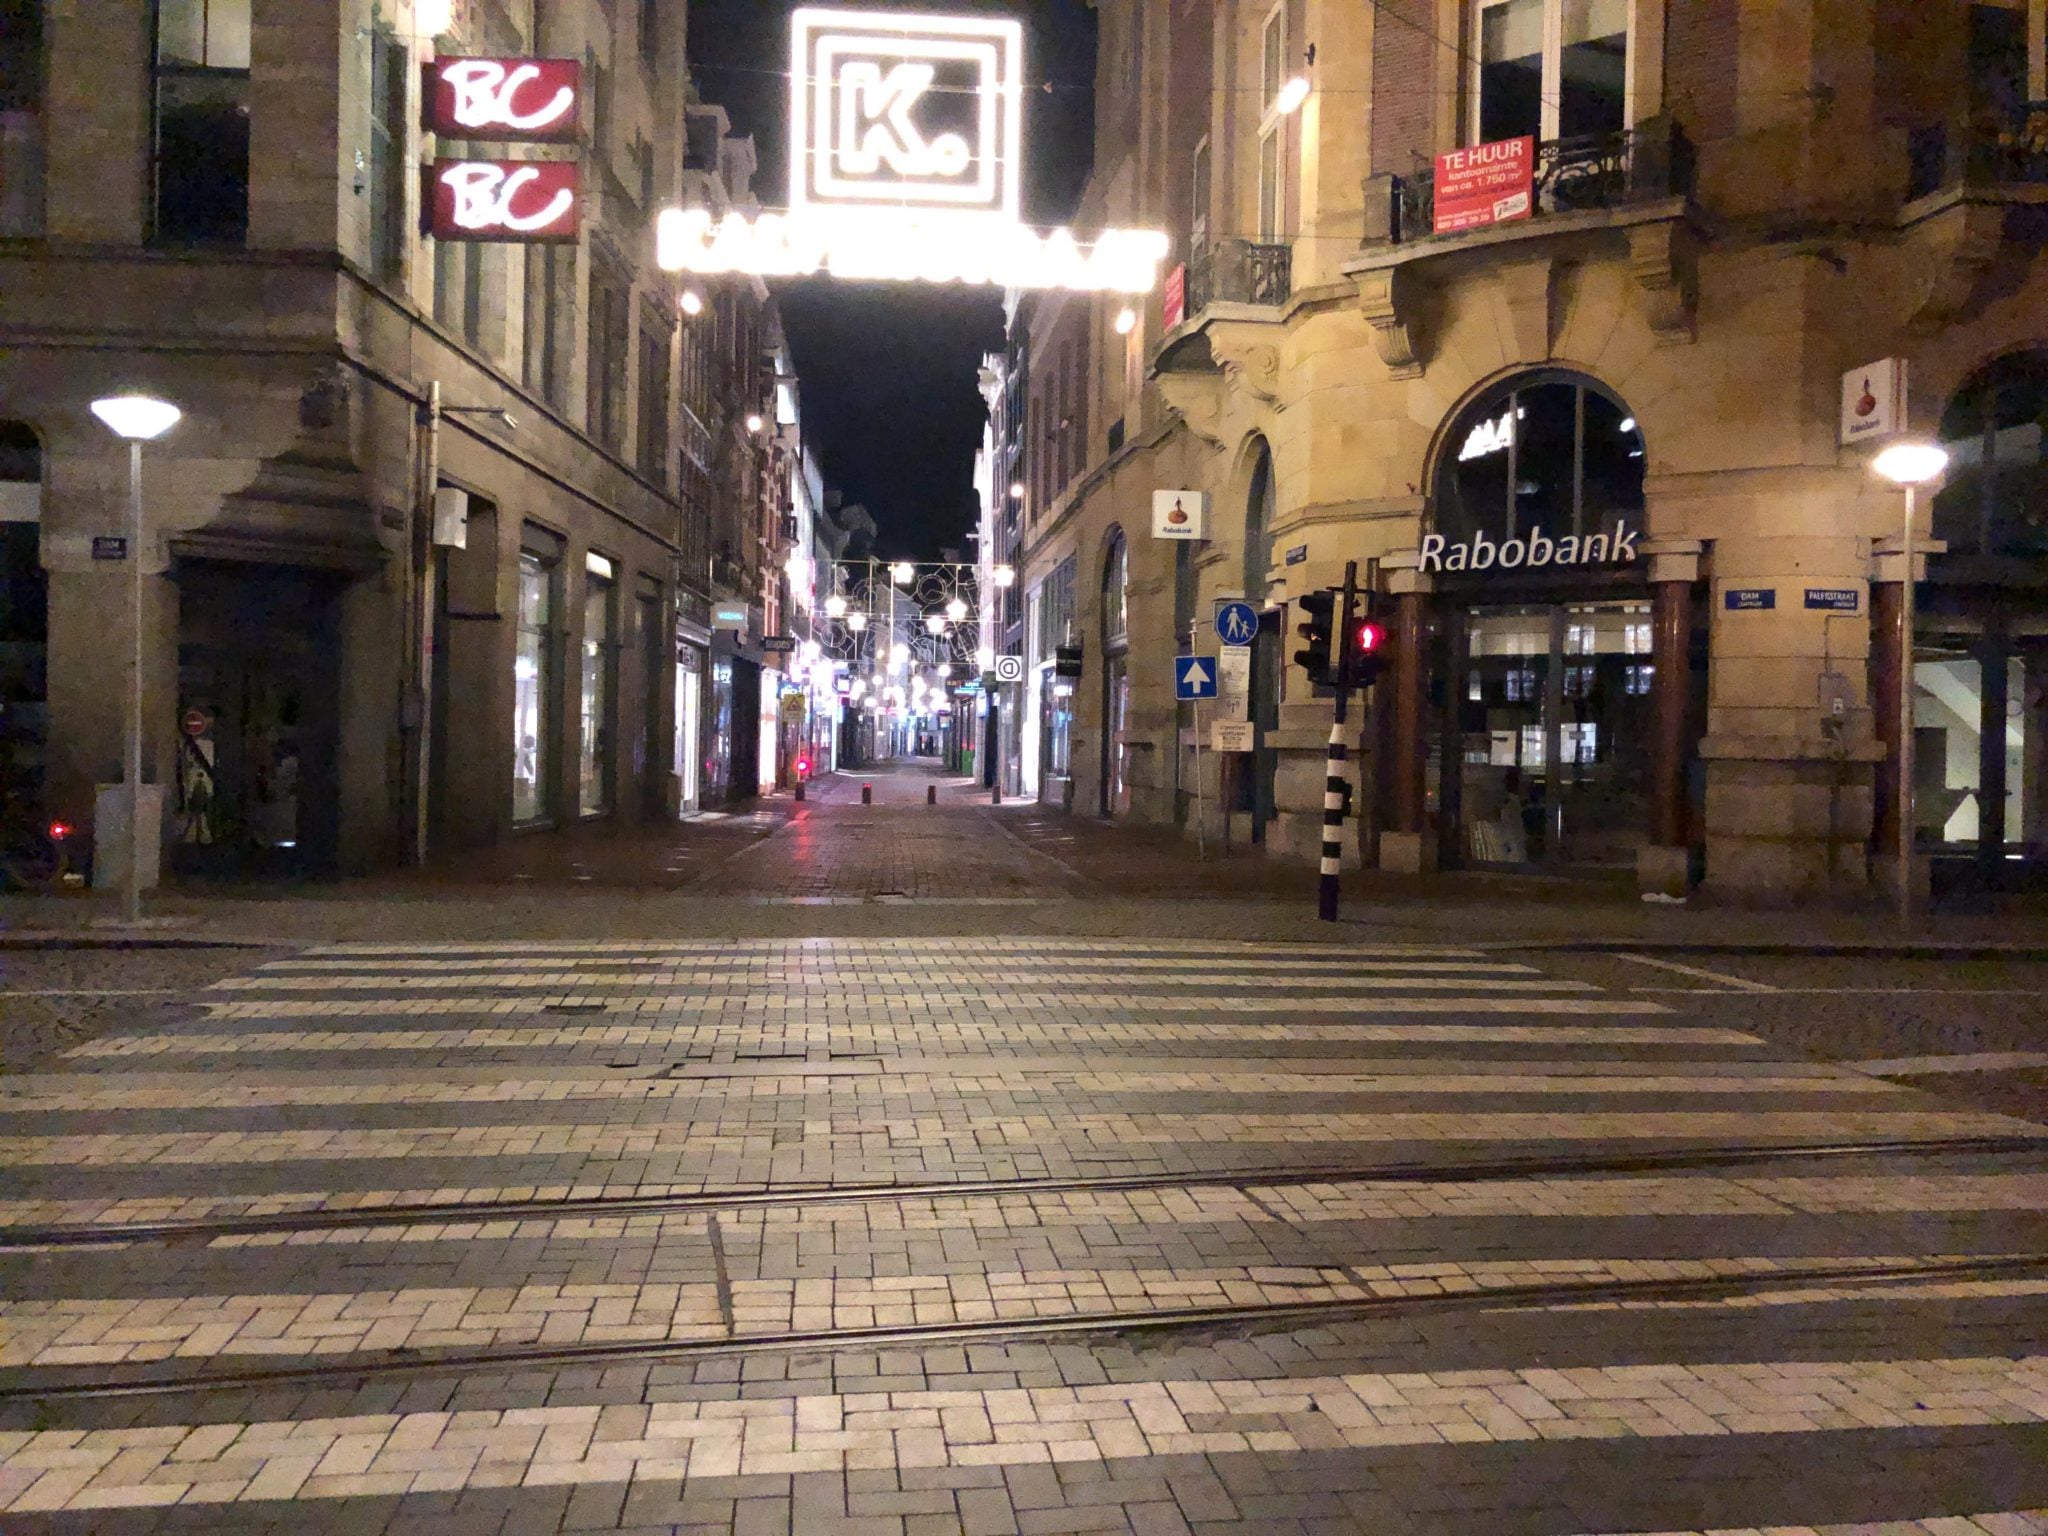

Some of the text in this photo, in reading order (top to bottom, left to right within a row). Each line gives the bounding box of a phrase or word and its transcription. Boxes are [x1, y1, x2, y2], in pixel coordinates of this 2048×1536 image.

[1442, 140, 1522, 170] TE HUUR
[1477, 173, 1506, 187] 1.750
[1419, 519, 1638, 573] Rabobank
[1741, 592, 1759, 600] DAM
